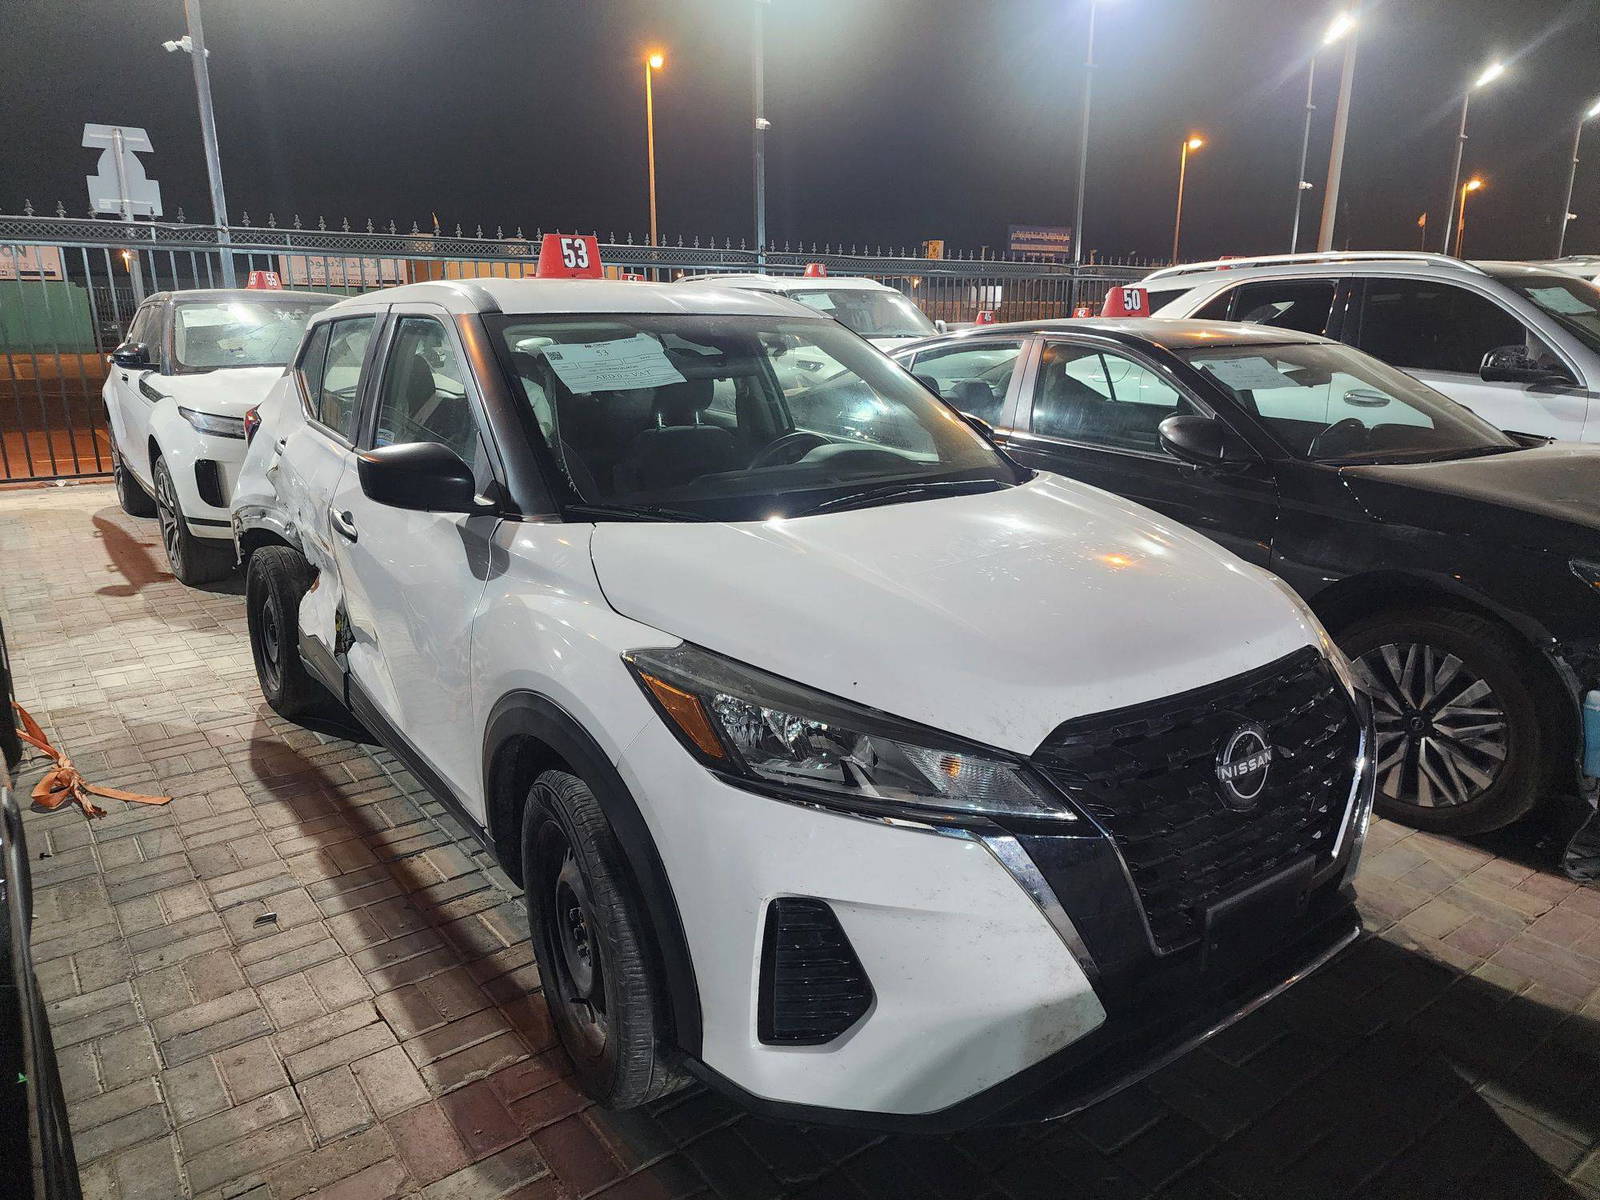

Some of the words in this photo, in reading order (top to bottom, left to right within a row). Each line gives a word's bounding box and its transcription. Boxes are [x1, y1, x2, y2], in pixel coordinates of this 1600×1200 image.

[560, 238, 589, 268] 53
[265, 272, 278, 286] 55
[1123, 289, 1141, 311] 50
[1220, 752, 1272, 779] NISSAN
